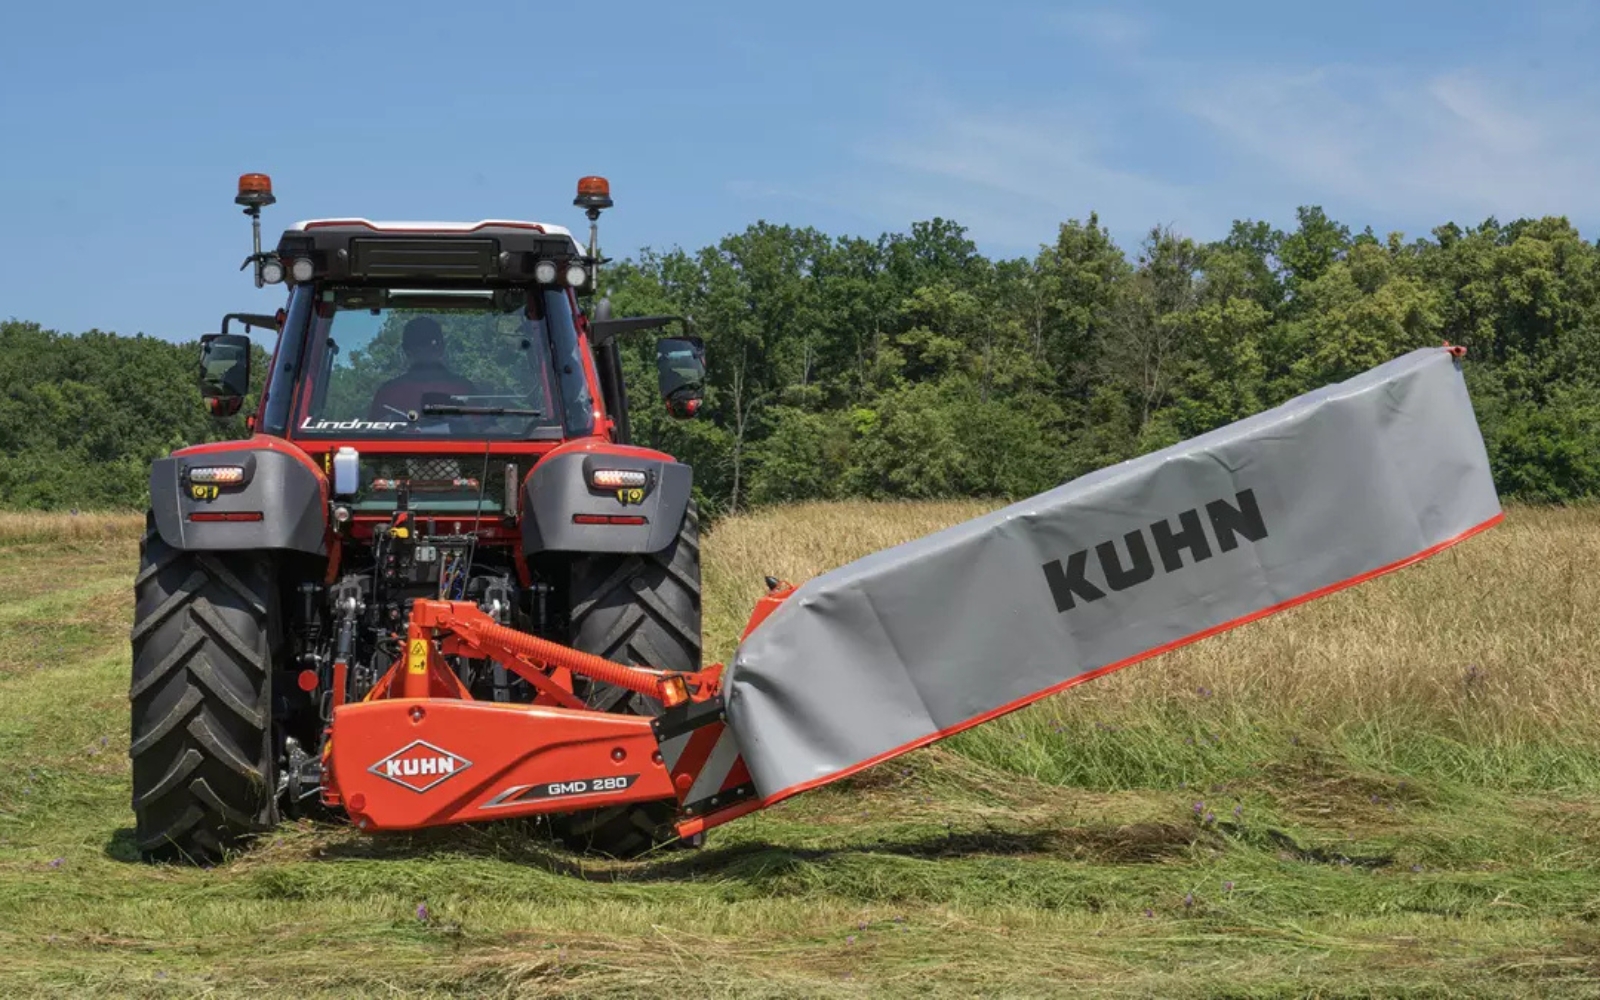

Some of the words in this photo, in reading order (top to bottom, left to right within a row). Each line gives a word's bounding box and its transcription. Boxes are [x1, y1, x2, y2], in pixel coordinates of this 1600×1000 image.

[300, 416, 408, 430] Lindner
[1042, 488, 1268, 613] KUHN
[386, 757, 454, 777] KUHN
[548, 781, 587, 795] GMD
[593, 777, 627, 791] 280
